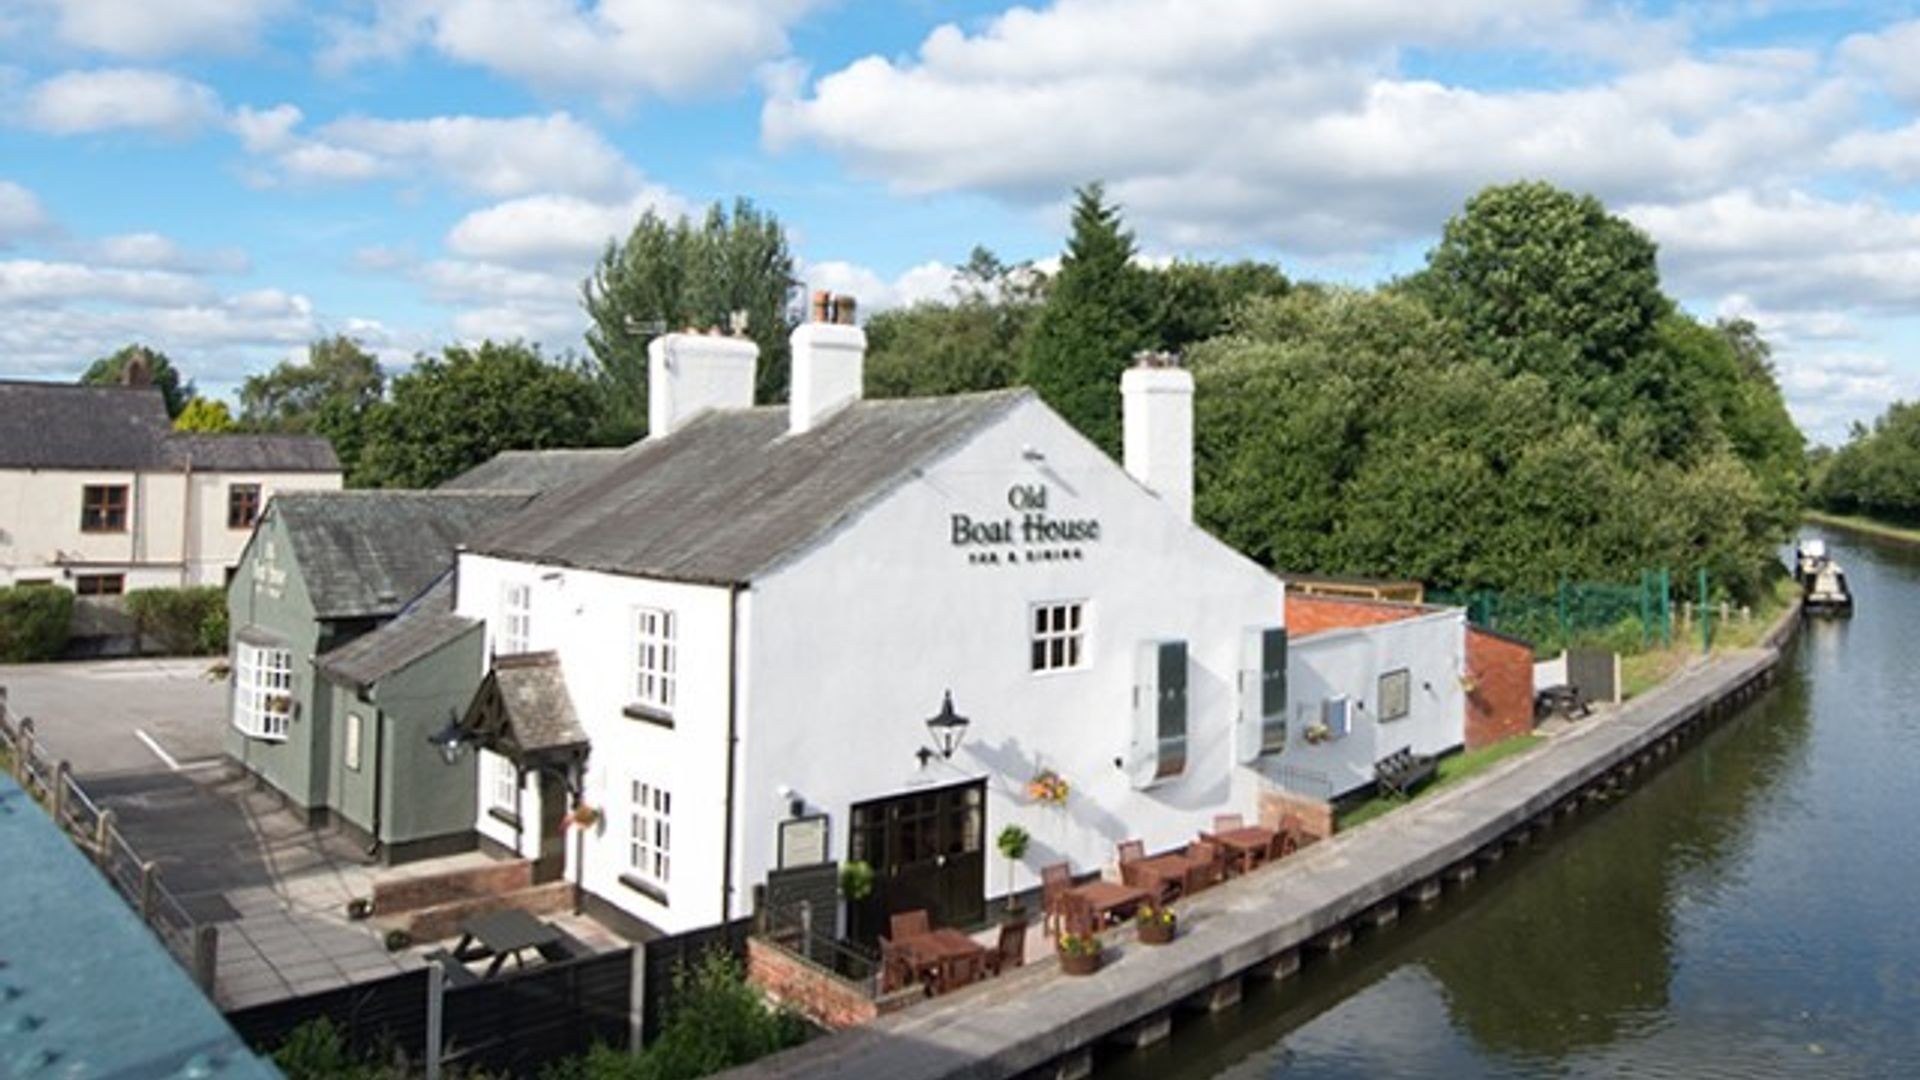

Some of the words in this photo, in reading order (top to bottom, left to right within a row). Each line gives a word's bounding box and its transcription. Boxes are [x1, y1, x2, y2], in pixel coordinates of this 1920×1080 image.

[1007, 483, 1047, 510] Old
[951, 513, 1012, 546] Boat
[1021, 512, 1100, 543] House
